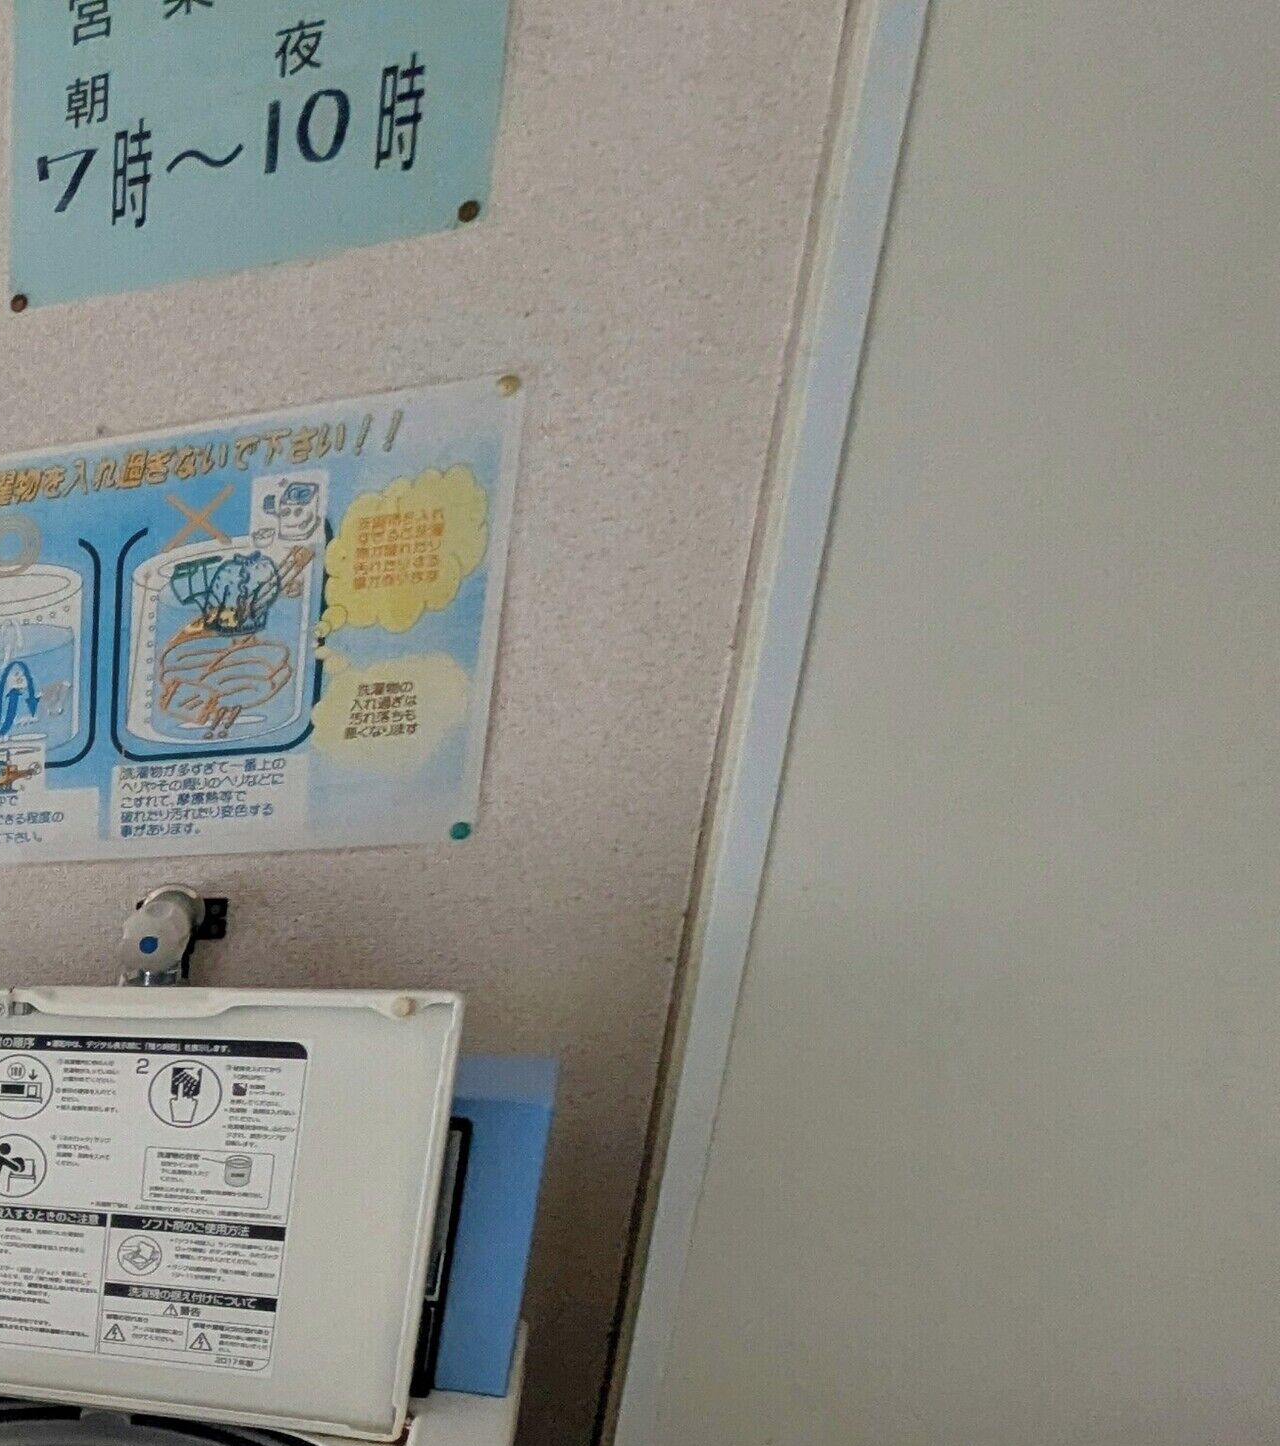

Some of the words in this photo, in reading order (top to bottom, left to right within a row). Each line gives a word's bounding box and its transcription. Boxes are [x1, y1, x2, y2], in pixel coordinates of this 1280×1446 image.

[275, 19, 326, 77] 夜
[66, 72, 110, 127] 朝
[136, 1058, 150, 1074] 2
[141, 1218, 251, 1237] ソフト剤のご使用方法
